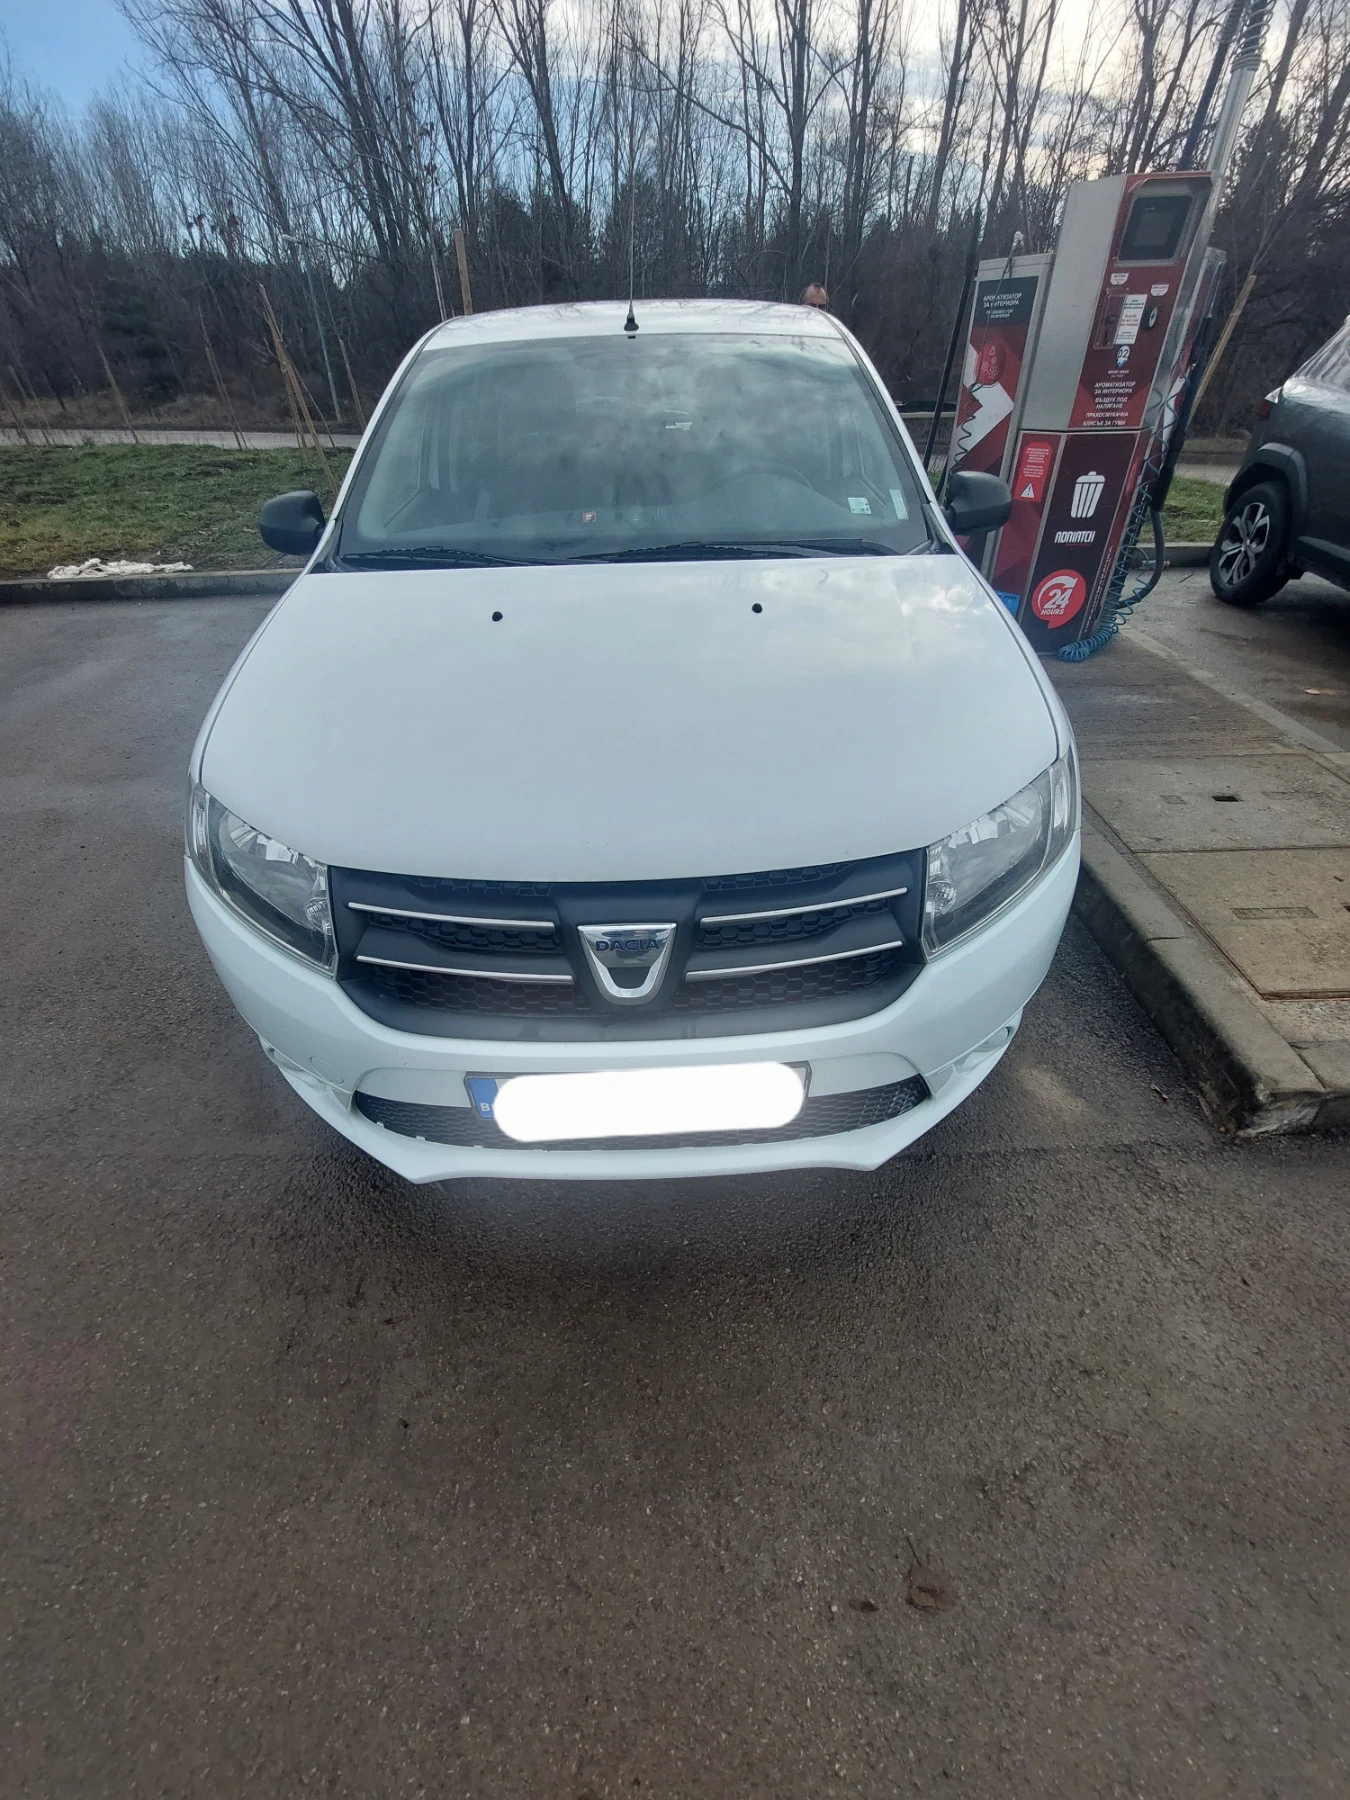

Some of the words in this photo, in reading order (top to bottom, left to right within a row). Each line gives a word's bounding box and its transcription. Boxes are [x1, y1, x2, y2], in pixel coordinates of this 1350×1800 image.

[1117, 348, 1130, 359] 02
[1043, 588, 1073, 609] 24
[1040, 607, 1065, 616] HOURS
[595, 939, 660, 952] DACIA
